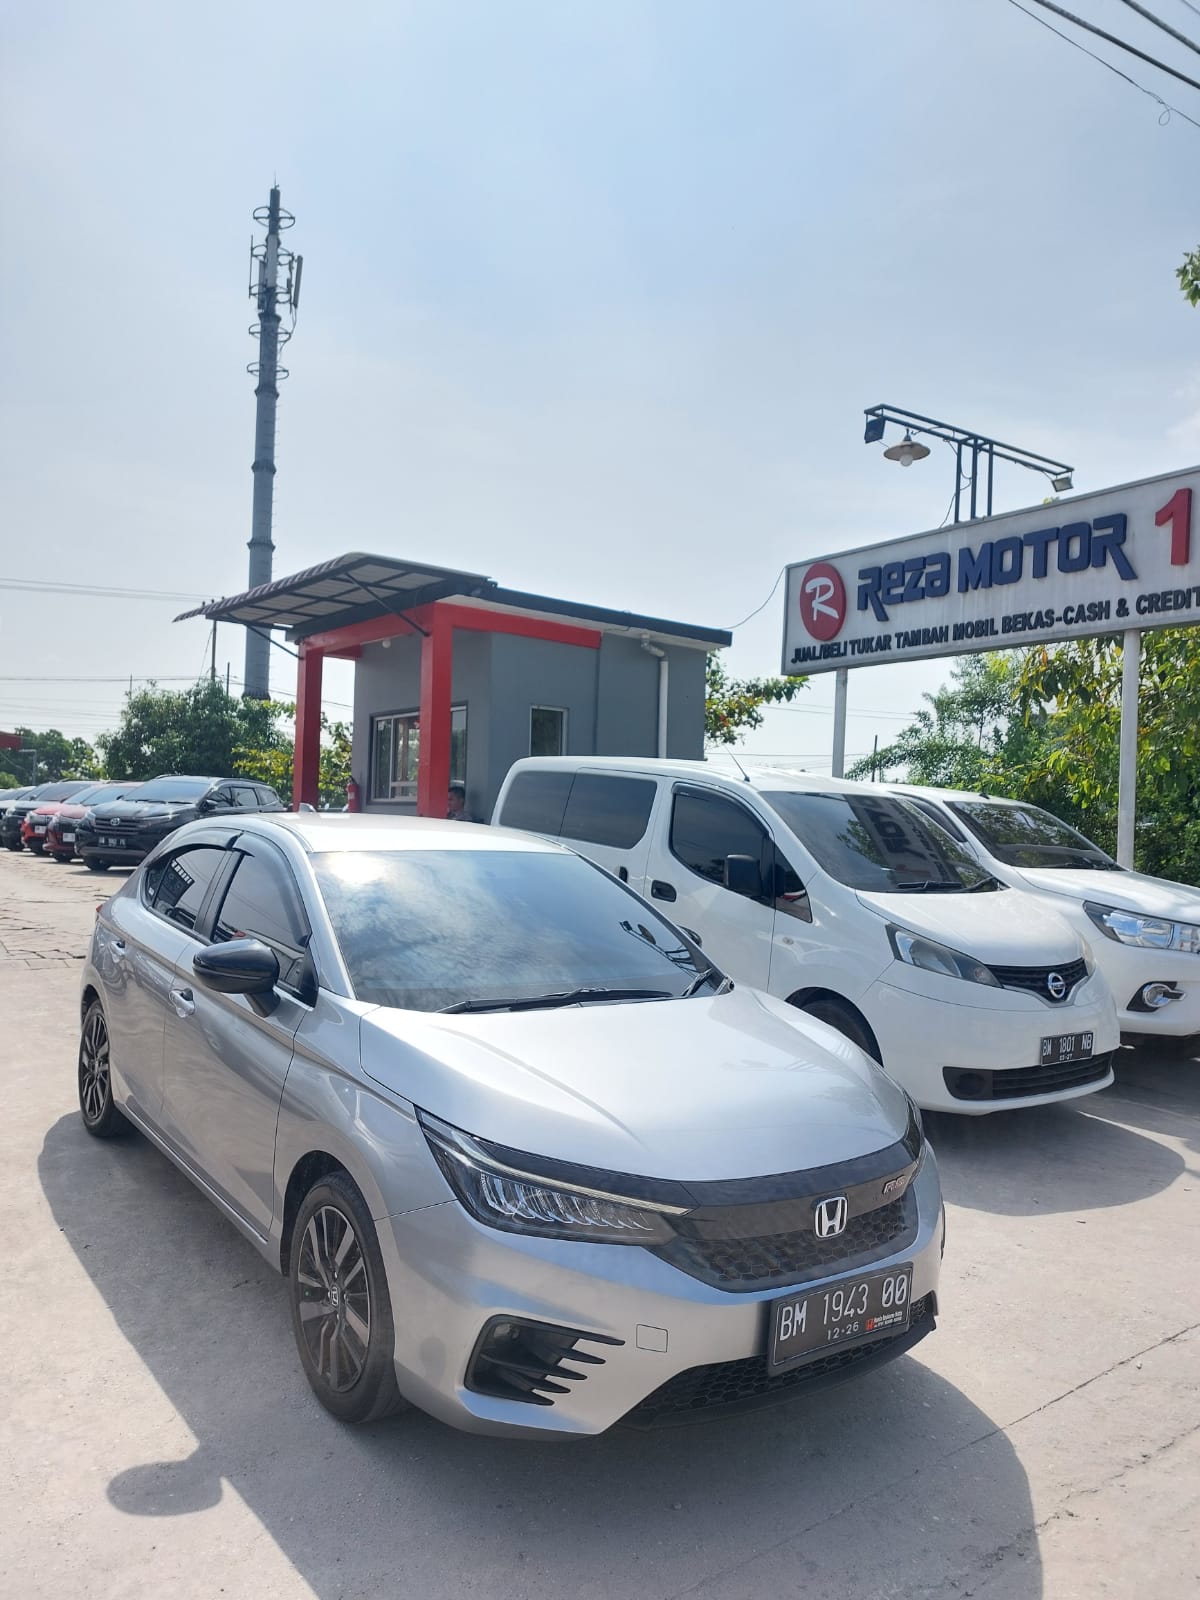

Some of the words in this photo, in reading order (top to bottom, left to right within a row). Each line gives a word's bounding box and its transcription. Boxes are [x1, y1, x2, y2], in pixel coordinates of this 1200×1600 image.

[957, 512, 1138, 593] MOTOR
[1154, 487, 1192, 566] 1
[849, 634, 892, 656] TUKAR
[894, 625, 949, 649] TAMBAH
[952, 617, 999, 641] MOBIL
[1001, 599, 1111, 634] BEKAS-CASH
[1115, 597, 1130, 618] &
[780, 1300, 808, 1341] BM
[823, 1283, 869, 1325] 1943
